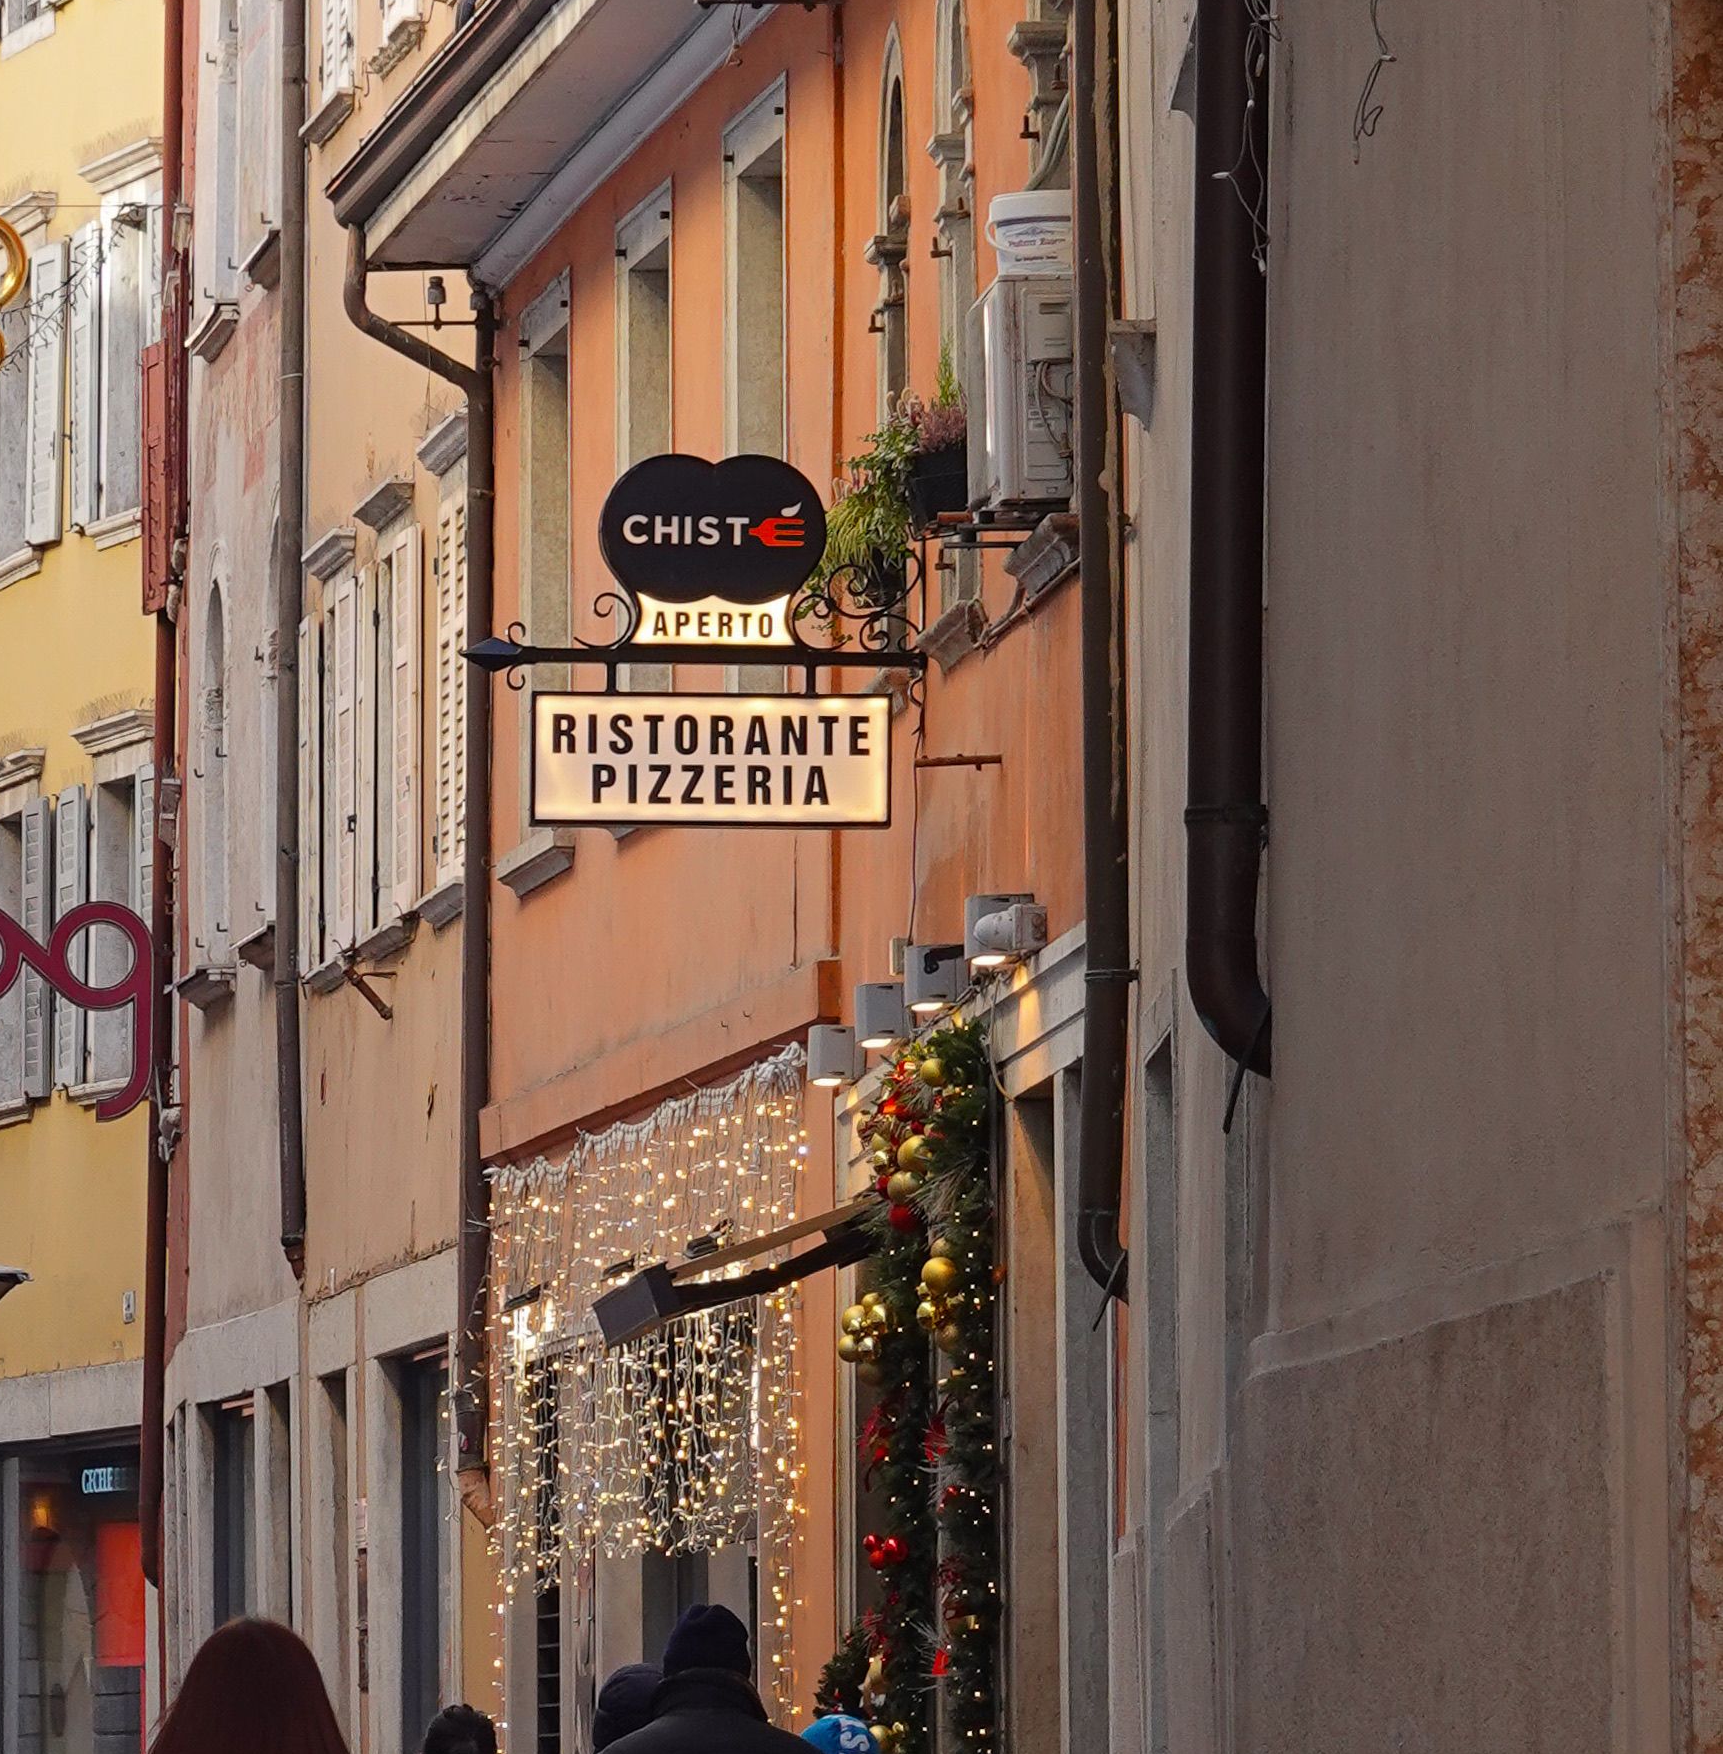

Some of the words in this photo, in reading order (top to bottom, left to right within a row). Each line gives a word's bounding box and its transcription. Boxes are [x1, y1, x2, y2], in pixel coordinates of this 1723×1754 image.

[622, 502, 805, 547] CHISTÉ
[652, 610, 774, 638] APERTO
[551, 713, 871, 756] RISTORANTE
[592, 764, 830, 806] PIZZERIA
